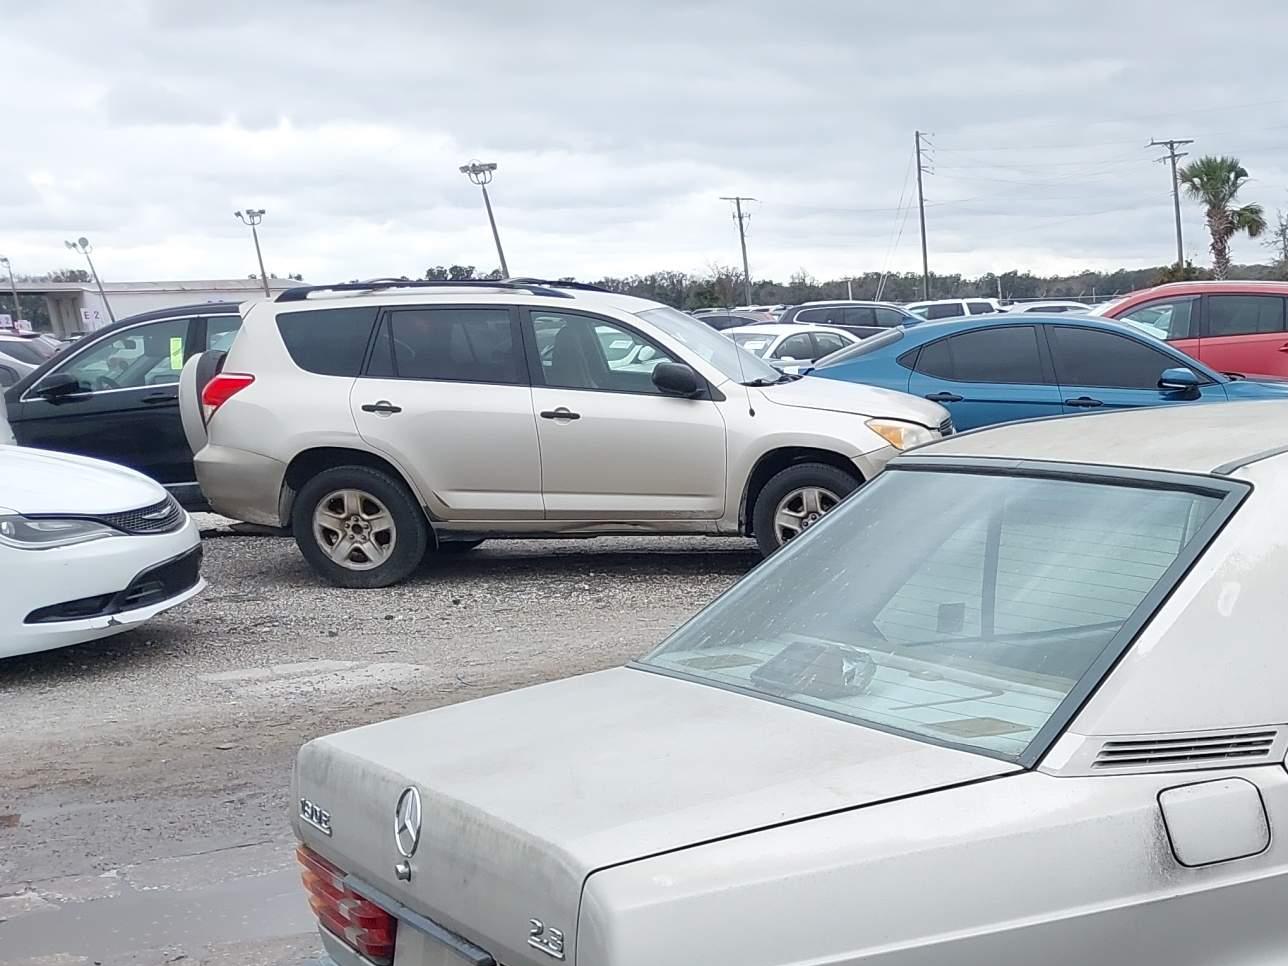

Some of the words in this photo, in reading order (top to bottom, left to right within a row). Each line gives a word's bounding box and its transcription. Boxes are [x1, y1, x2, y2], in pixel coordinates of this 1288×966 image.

[84, 311, 91, 320] E
[94, 311, 100, 320] 2
[529, 917, 564, 955] 2.3
